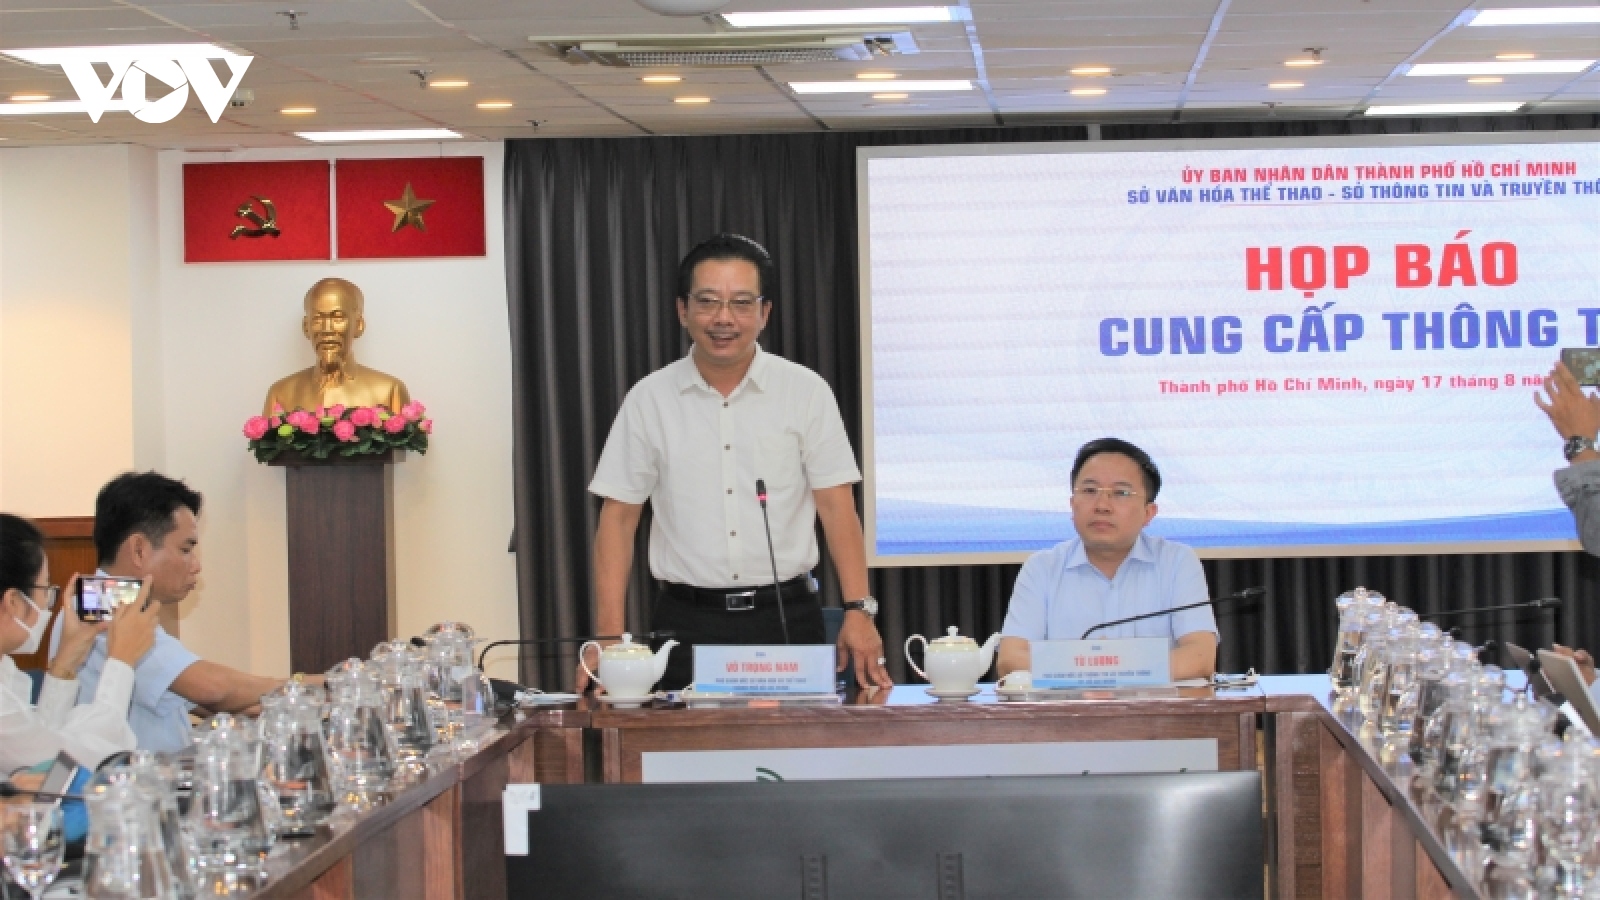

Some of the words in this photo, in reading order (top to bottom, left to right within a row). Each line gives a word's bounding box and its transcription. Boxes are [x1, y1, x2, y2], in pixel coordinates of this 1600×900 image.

[1209, 167, 1247, 183] BAN
[1253, 164, 1305, 181] NHÂN
[1311, 164, 1349, 181] DÂN
[1355, 162, 1415, 179] THÀNH
[1420, 160, 1456, 178] PHỐ
[1461, 160, 1485, 178] HỒ
[1491, 160, 1521, 177] CHÍ
[1526, 162, 1578, 177] MINH
[1155, 186, 1193, 203] VĂN
[1199, 184, 1234, 203] HÓA
[1239, 182, 1271, 201] THỂ
[1277, 187, 1323, 201] THAO
[1370, 182, 1429, 198] THÔNG
[1436, 184, 1465, 197] TIN
[1471, 180, 1494, 197] VÀ
[1500, 178, 1566, 196] TRUYỀN
[1246, 245, 1370, 298] HỌP
[1395, 230, 1518, 288] BÁO
[1100, 315, 1243, 356] CUNG
[1263, 302, 1364, 353] CẤP
[1382, 302, 1558, 351] THÔNG
[1159, 380, 1211, 393] Thành
[1217, 379, 1249, 396] phố
[1284, 378, 1312, 391] Chí
[1317, 377, 1368, 392] Minh,
[1374, 377, 1415, 391] ngày
[1422, 376, 1442, 387] 17
[1450, 375, 1498, 389] tháng
[1504, 374, 1516, 386] 8
